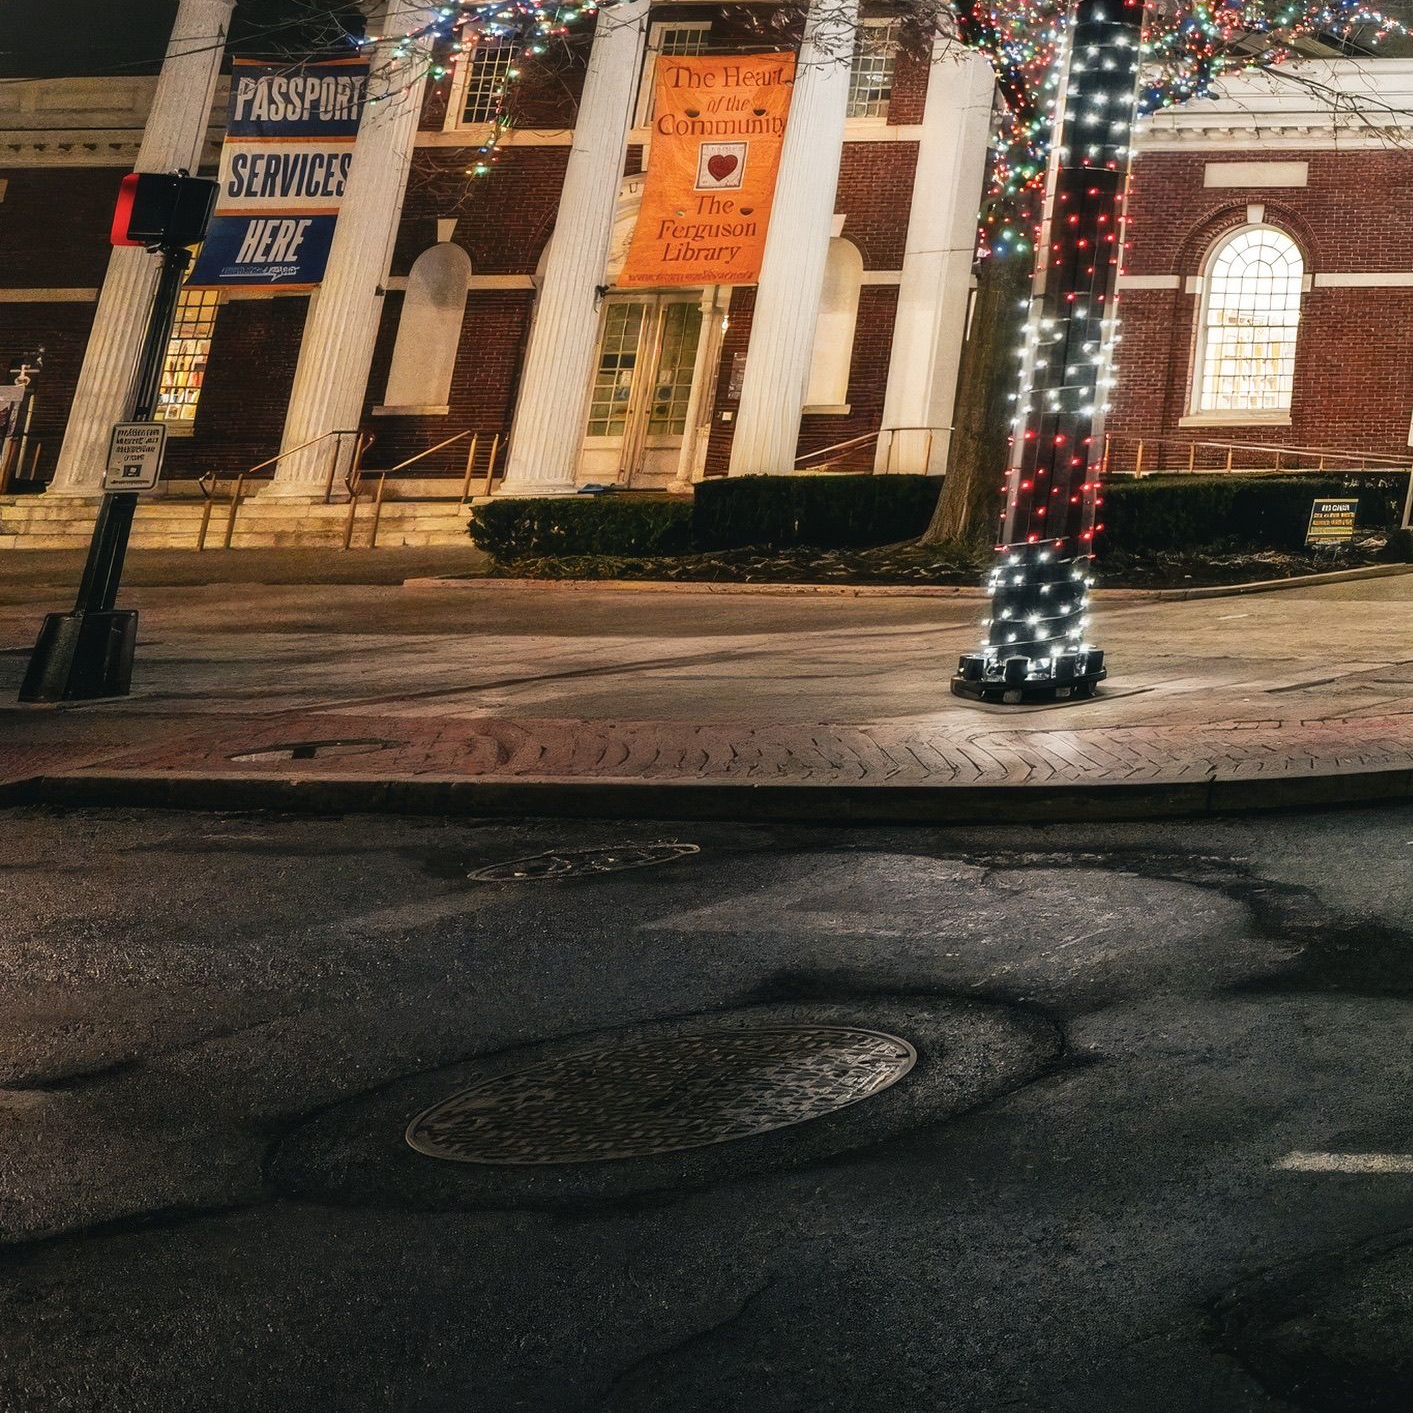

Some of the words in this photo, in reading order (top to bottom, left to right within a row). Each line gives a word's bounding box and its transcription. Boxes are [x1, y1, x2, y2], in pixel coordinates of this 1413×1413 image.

[664, 66, 716, 88] The
[722, 65, 785, 88] Heart
[233, 75, 366, 121] PASSPORT
[706, 95, 726, 112] of
[725, 95, 750, 111] the
[227, 152, 353, 198] SERVICES
[696, 195, 735, 215] The
[656, 219, 757, 241] Ferguson
[235, 219, 313, 264] HERE
[660, 242, 741, 264] Library
